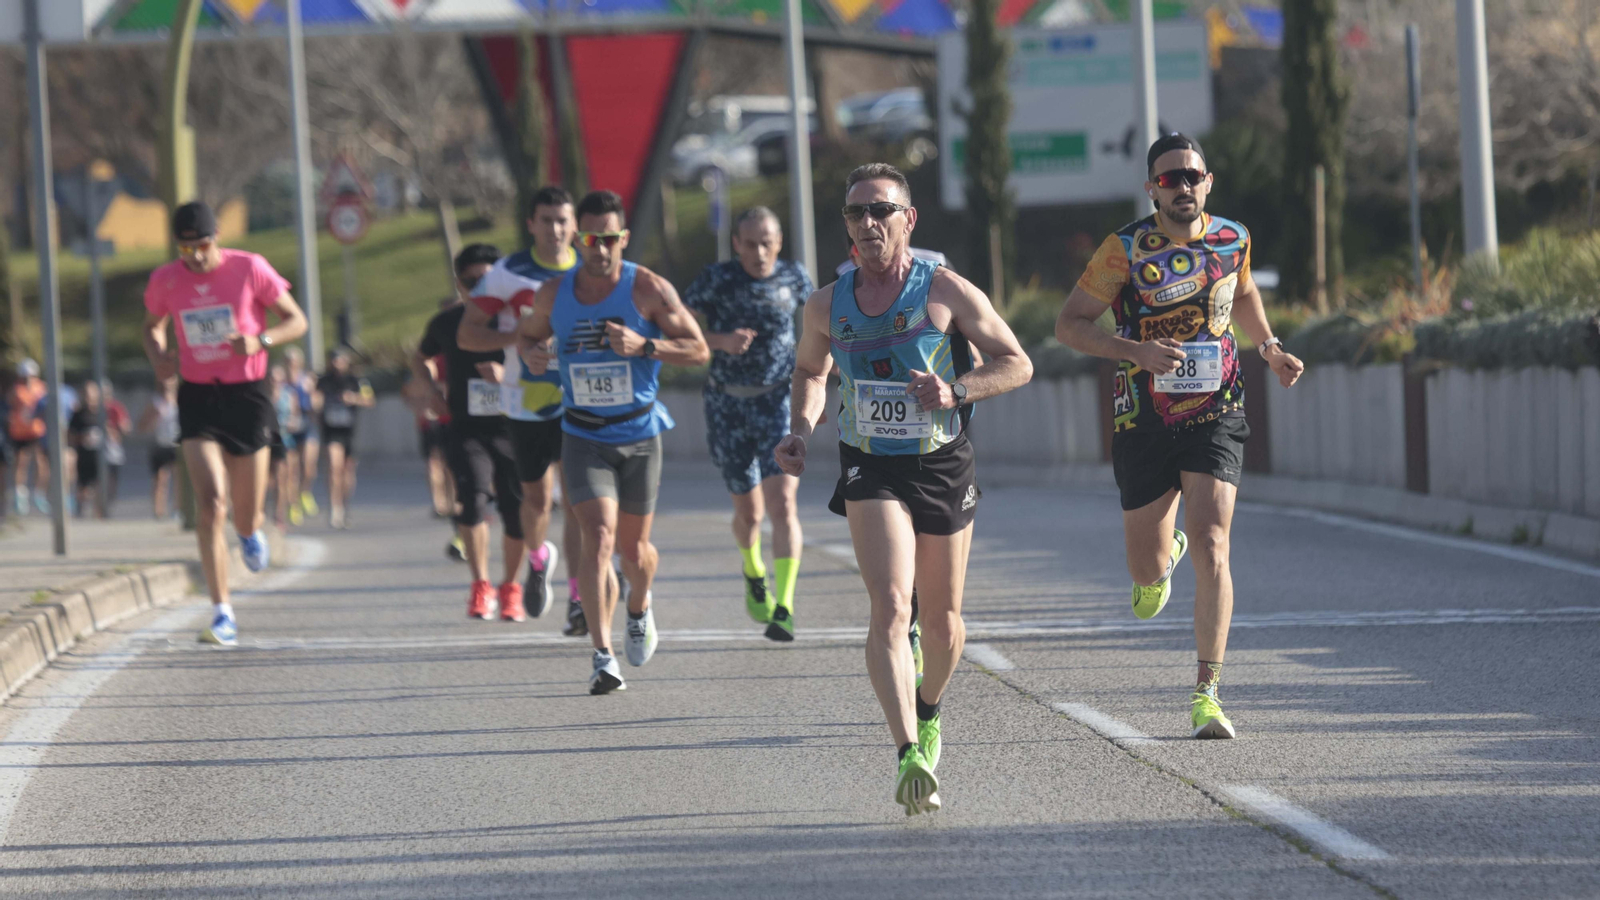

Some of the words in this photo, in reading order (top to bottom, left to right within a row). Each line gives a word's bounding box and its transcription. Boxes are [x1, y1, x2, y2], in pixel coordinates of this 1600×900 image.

[1175, 358, 1197, 378] 88
[584, 377, 613, 393] 148
[1171, 382, 1203, 390] EVOS
[874, 388, 906, 396] MARATÓN
[870, 399, 907, 423] 209
[874, 426, 908, 436] EVOS
